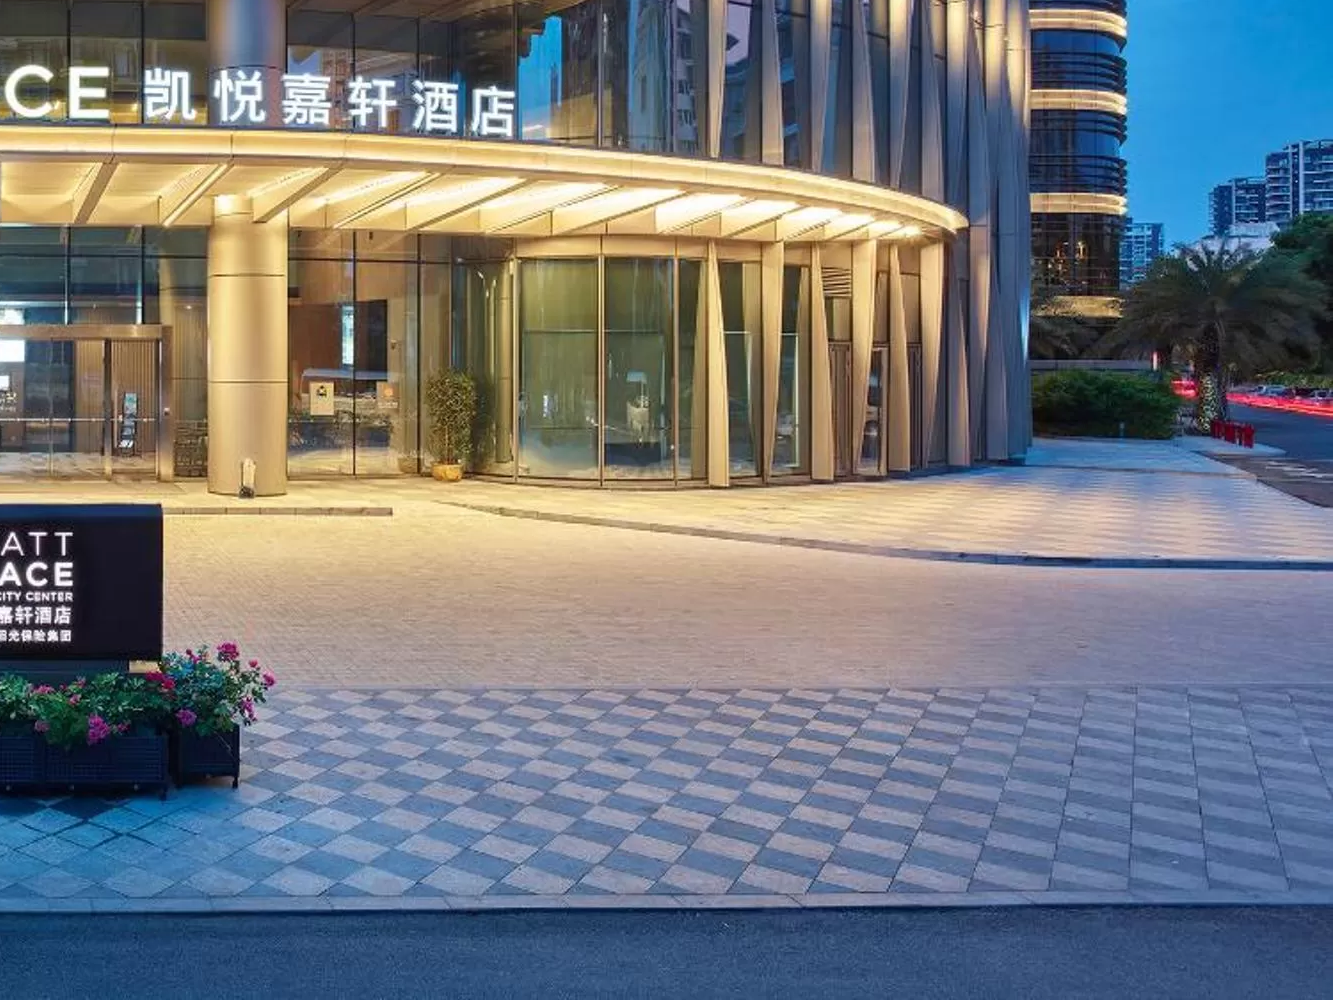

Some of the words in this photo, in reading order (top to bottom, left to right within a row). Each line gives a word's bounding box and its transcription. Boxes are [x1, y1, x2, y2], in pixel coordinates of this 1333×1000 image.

[144, 67, 516, 137] 凯悦嘉轩酒店
[26, 591, 74, 602] CENTER
